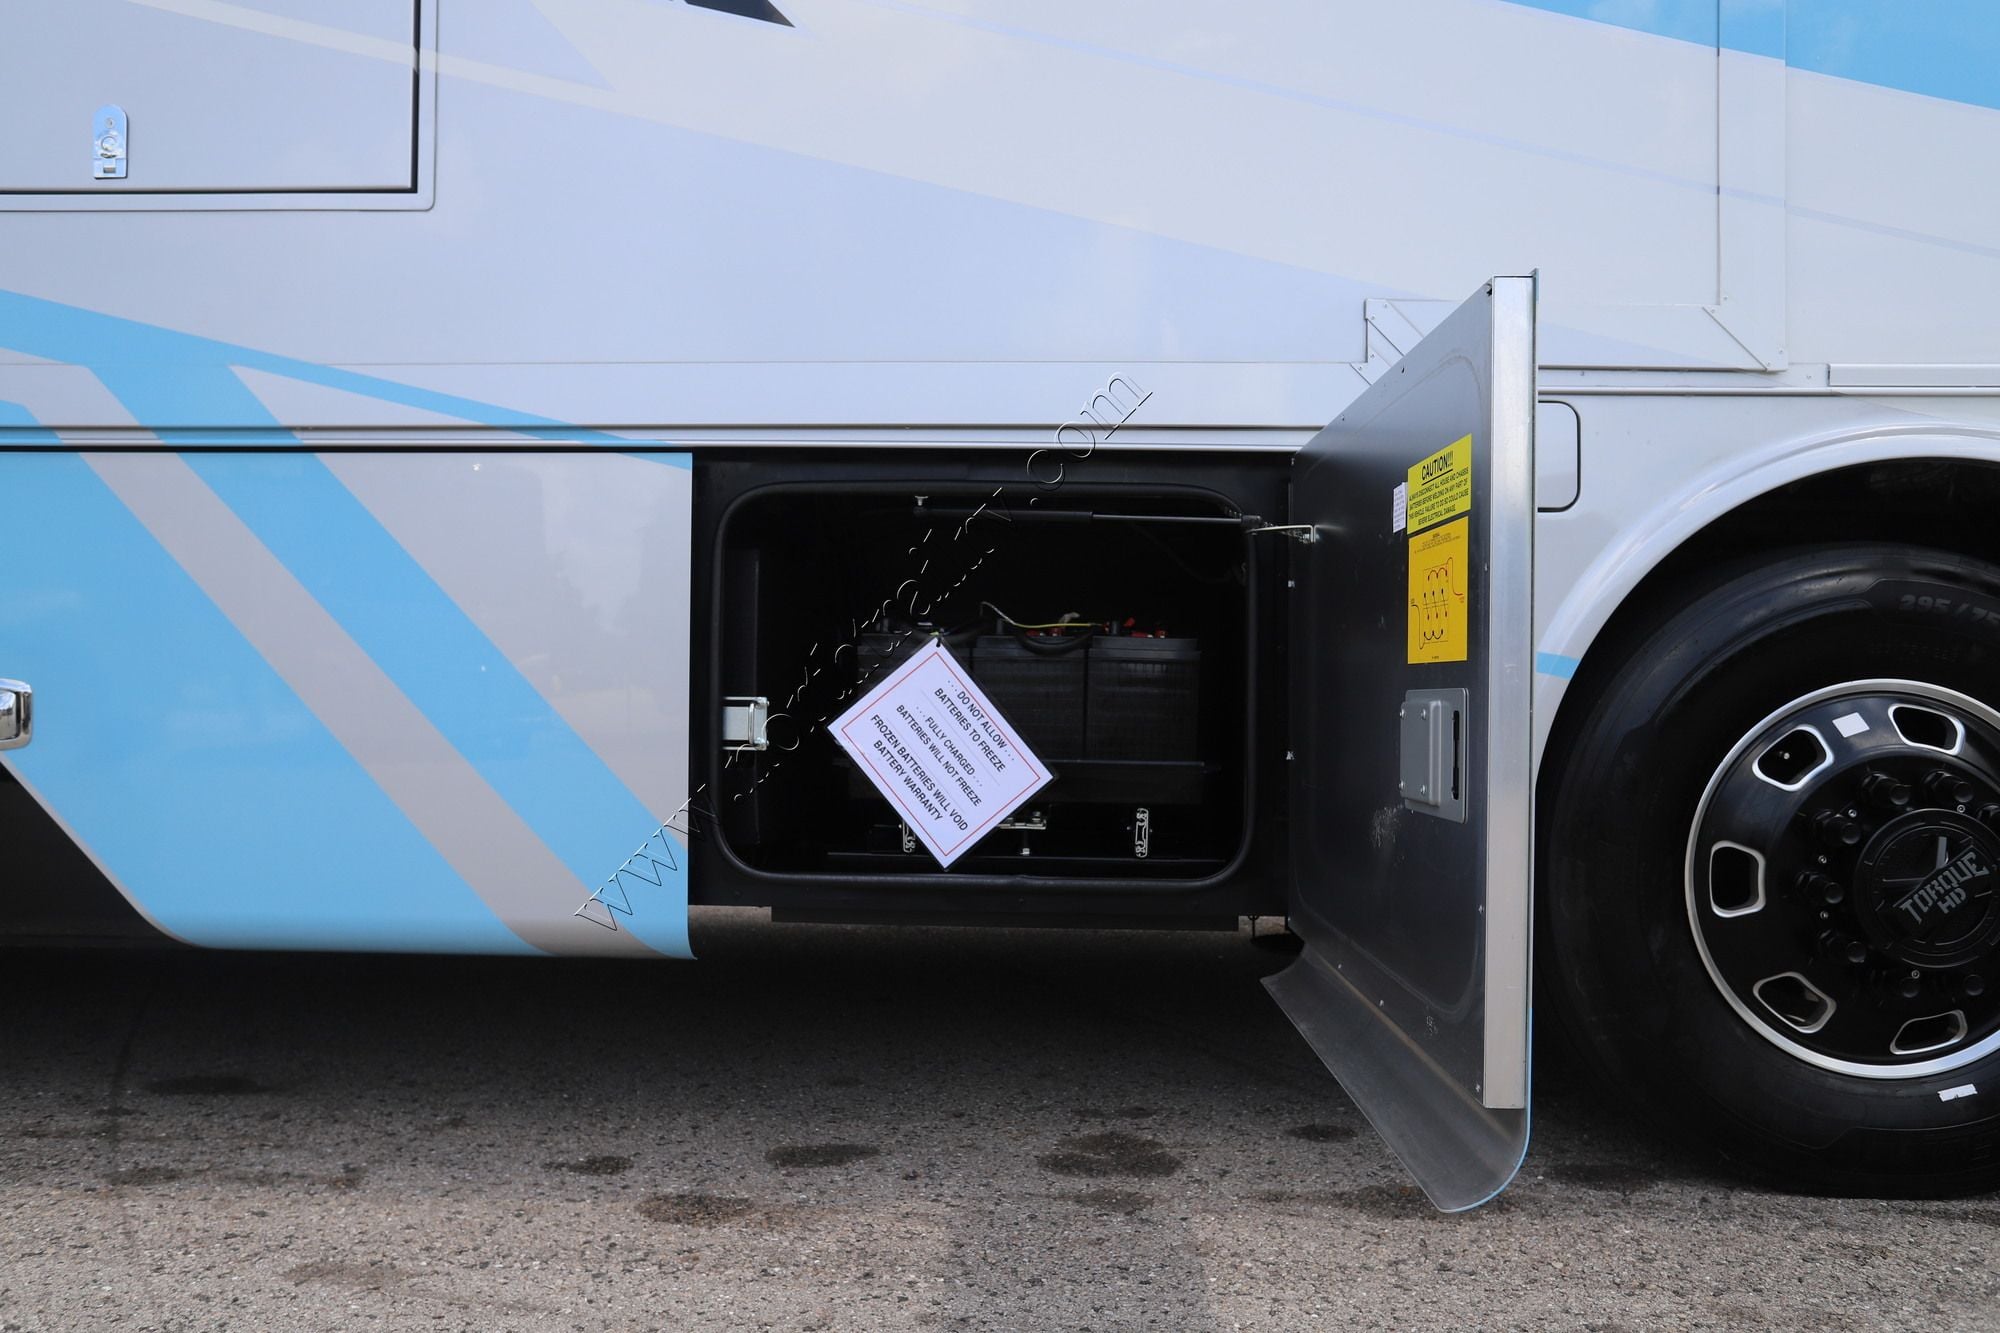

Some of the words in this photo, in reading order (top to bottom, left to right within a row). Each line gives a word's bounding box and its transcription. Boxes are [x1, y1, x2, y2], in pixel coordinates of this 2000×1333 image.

[896, 705, 931, 744] BATTERIES
[928, 743, 944, 763] WILL
[942, 761, 959, 777] NOT
[955, 776, 981, 806] FREEZE
[925, 716, 946, 739] FULLY
[944, 739, 975, 775] CHARGED
[934, 688, 971, 731] BATTERIES
[969, 728, 980, 742] TO
[978, 740, 1005, 772] FREEZE
[957, 691, 970, 704] DO
[967, 703, 984, 720] NOT
[980, 721, 1007, 748] ALLOW
[871, 714, 901, 748] FROZEN
[897, 746, 935, 791] BATTERIES
[933, 789, 950, 811] WILL
[949, 809, 968, 830] VOID
[873, 740, 906, 776] BATTERY
[903, 775, 943, 820] WARRANTY
[1900, 852, 1990, 925] TORQUE
[1937, 887, 1966, 914] HD
